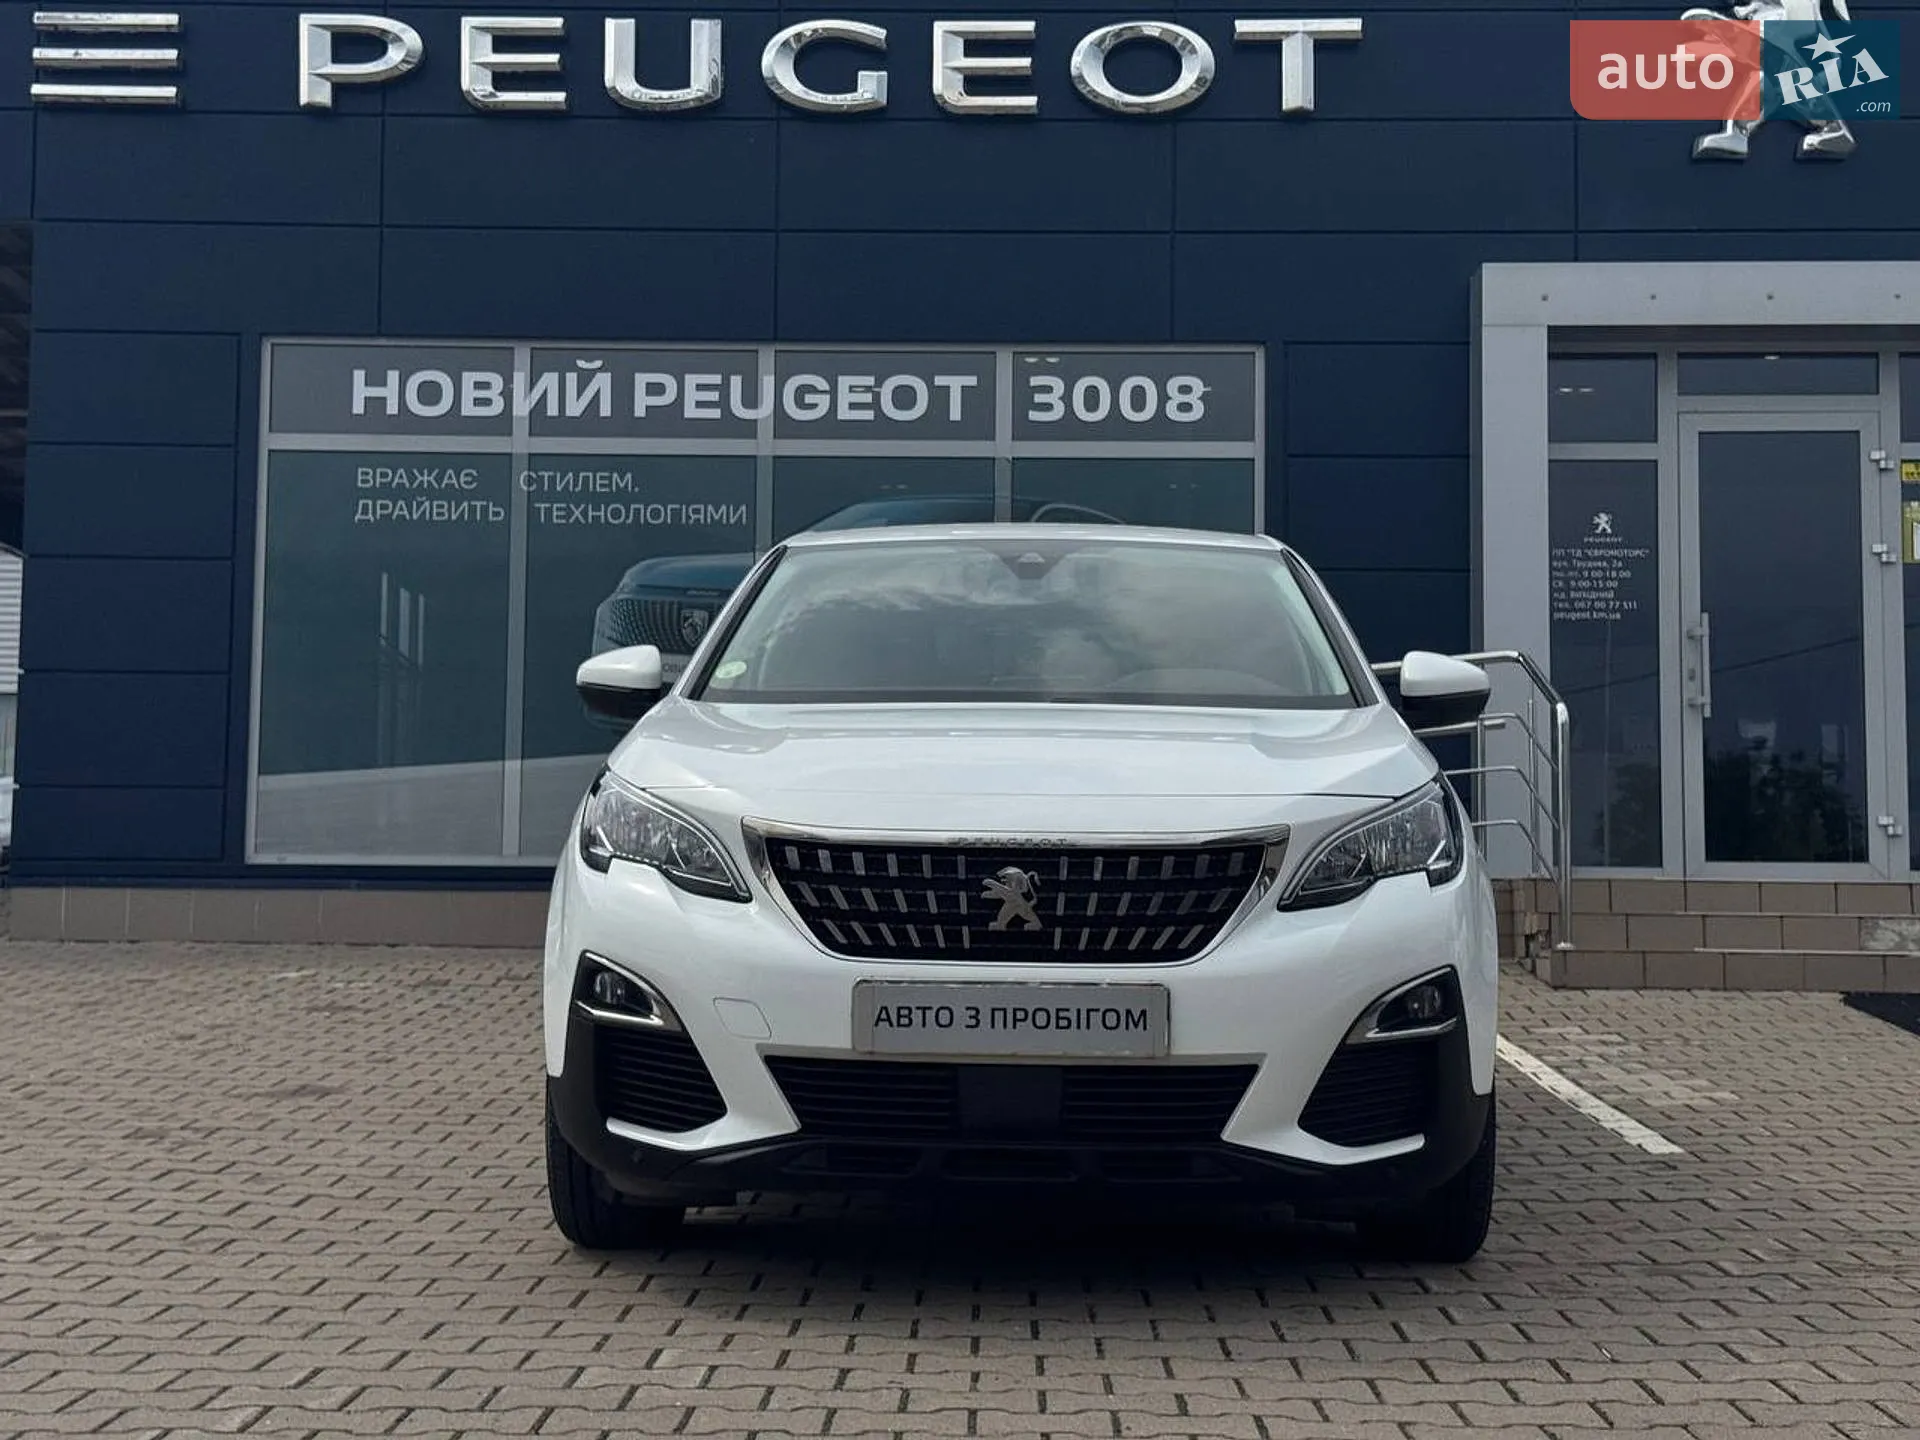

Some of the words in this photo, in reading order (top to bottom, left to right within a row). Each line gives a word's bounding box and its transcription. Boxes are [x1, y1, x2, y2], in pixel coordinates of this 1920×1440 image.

[299, 13, 1363, 115] PEUGEOT
[351, 359, 612, 418] НОВИЙ
[634, 372, 978, 422] PEUGEOT
[1028, 375, 1206, 423] 3008
[356, 467, 478, 490] ВРАЖАЄ
[519, 471, 640, 493] СТИЛЕМ.
[354, 498, 505, 523] ДРАЙВИТЬ
[535, 502, 748, 526] ТЕХНОЛОГІЯМИ
[873, 1006, 955, 1029] АВТО
[964, 1006, 981, 1030] З
[990, 1007, 1149, 1031] ПРОБІГОМ
